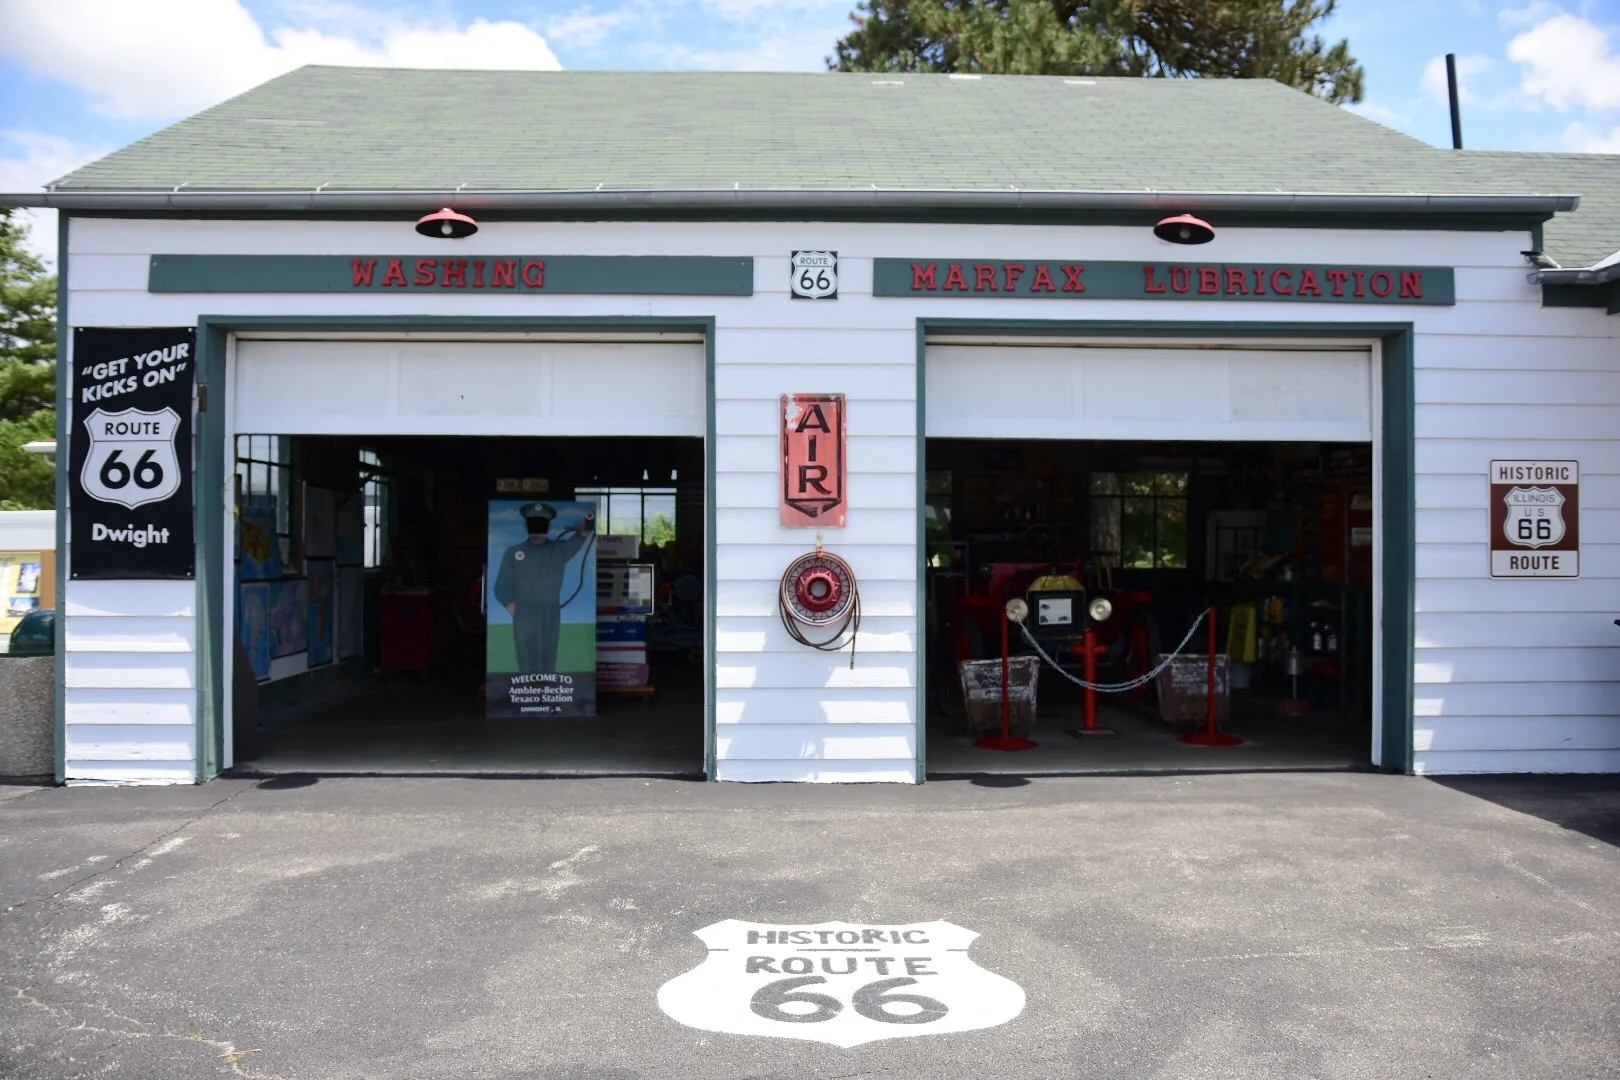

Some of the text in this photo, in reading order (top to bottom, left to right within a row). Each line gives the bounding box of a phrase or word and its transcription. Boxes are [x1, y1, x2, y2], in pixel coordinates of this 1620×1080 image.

[800, 257, 828, 265] ROUTE
[351, 259, 546, 288] WASHING
[800, 268, 830, 290] 66
[911, 263, 1424, 299] MARFAX LUBRICATION
[133, 342, 189, 370] YOUR
[81, 375, 138, 404] KICKS
[105, 422, 160, 435] ROUTE
[795, 404, 833, 496] AIR
[99, 449, 164, 489] 66
[1500, 466, 1569, 480] HISTORIC
[1513, 494, 1555, 503] ILLINOIS
[91, 523, 170, 548] Dwight
[1518, 518, 1551, 540] 66
[1510, 555, 1560, 570] ROUTE
[510, 673, 573, 685] WELCOME TO
[508, 685, 575, 695] Ambler-Becker
[510, 693, 573, 703] Texaco Station
[746, 930, 930, 945] HISTORIC
[745, 955, 938, 976] ROUTE
[749, 975, 949, 1025] 66
